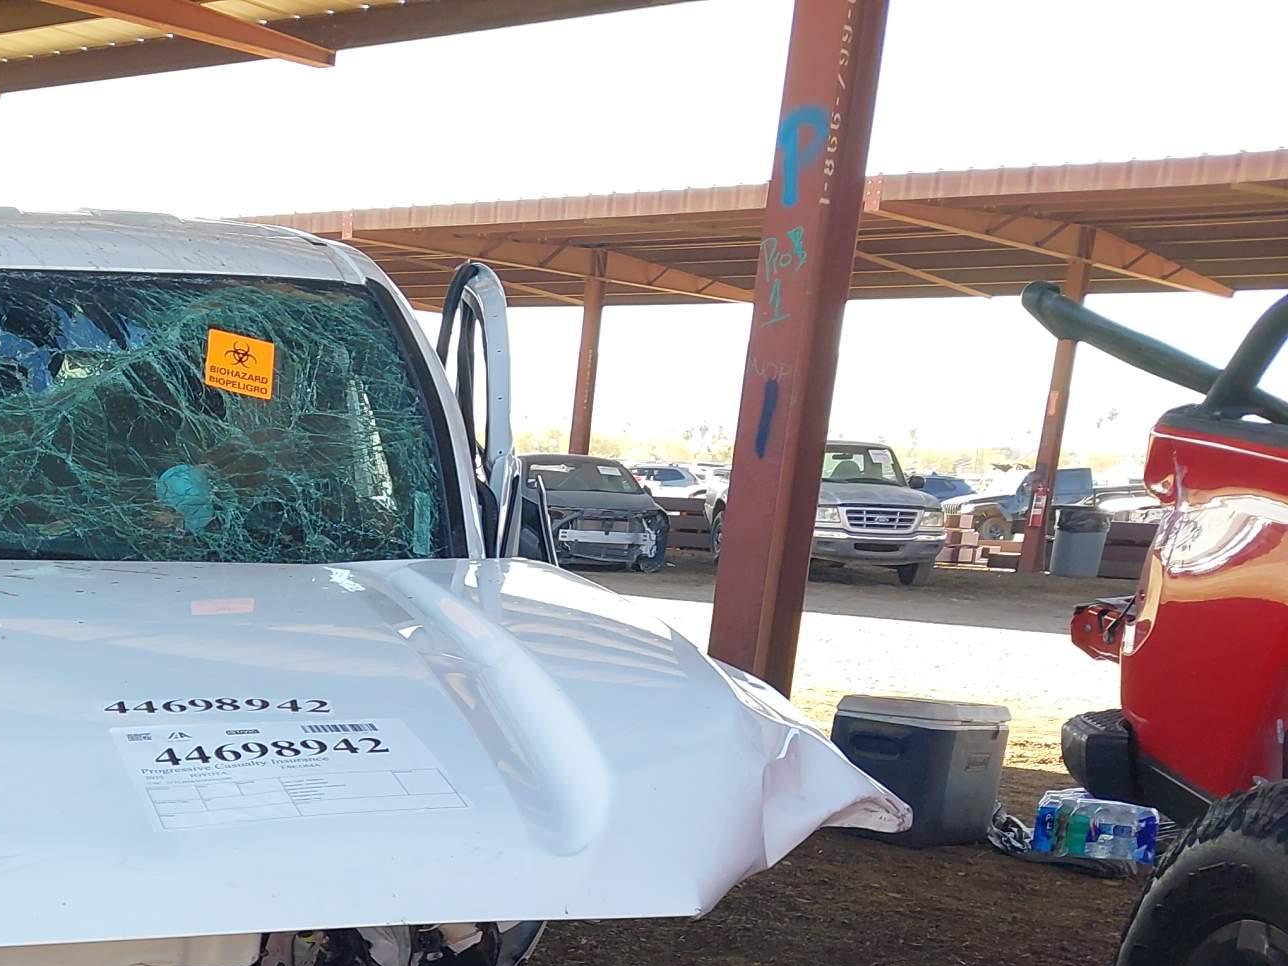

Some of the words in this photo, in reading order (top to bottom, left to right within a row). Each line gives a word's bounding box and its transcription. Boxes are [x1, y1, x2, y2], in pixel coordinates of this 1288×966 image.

[779, 104, 830, 208] P
[210, 365, 268, 384] BIOHAZARD
[209, 375, 268, 394] BIOPELIGRO
[104, 698, 331, 714] 44698942
[155, 737, 390, 766] 44698942
[141, 764, 211, 775] Progressive
[214, 760, 266, 770] Casualty
[271, 756, 329, 765] Insurance
